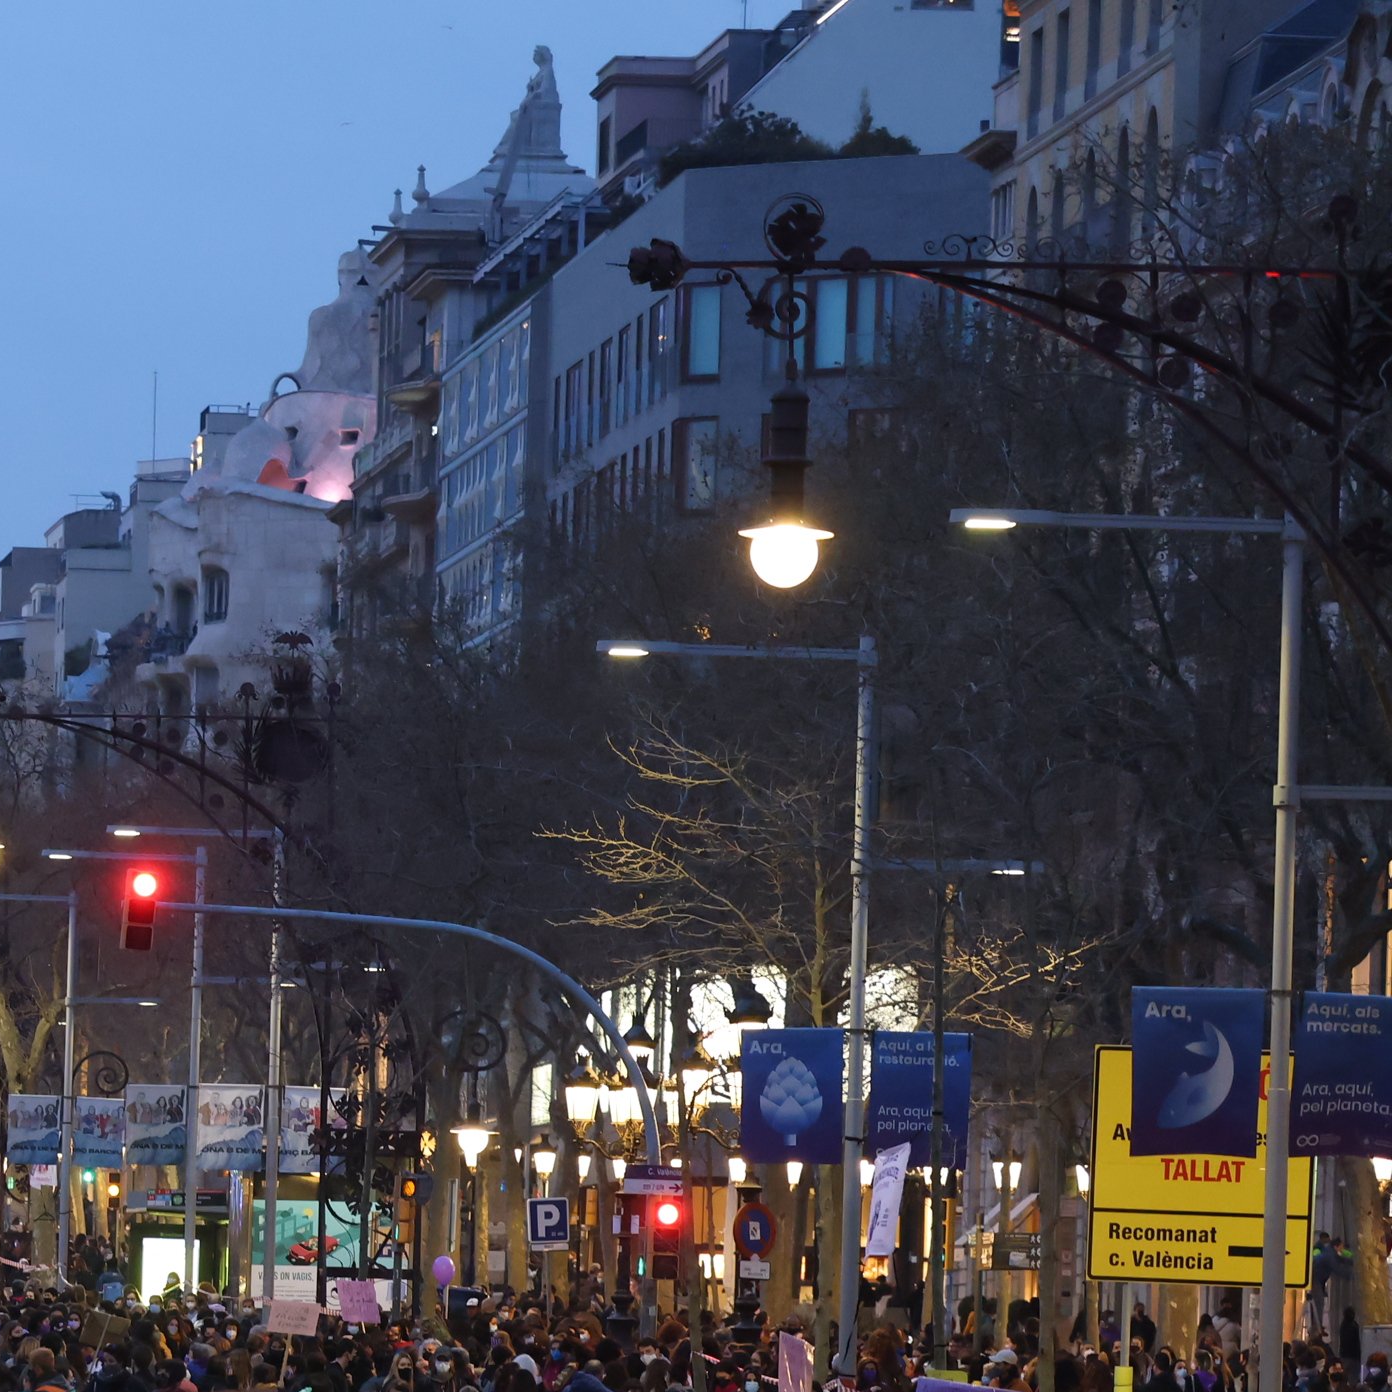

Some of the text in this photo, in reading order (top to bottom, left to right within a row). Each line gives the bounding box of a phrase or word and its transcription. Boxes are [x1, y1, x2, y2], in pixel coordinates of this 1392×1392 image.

[1145, 1001, 1192, 1022] Ara,
[1307, 1002, 1381, 1019] Aquí, als
[1306, 1020, 1382, 1035] mercats.
[749, 1039, 786, 1057] Ara,
[878, 1040, 913, 1053] Aquí,
[916, 1042, 925, 1052] a
[878, 1054, 960, 1067] restauraió.
[1302, 1081, 1374, 1098] Ara, aquí,
[877, 1105, 934, 1119] Ara, aquí
[1300, 1099, 1324, 1117] pel
[877, 1119, 952, 1134] pel planea.
[1160, 1158, 1245, 1183] TALLAT
[537, 1203, 561, 1238] P
[1109, 1222, 1217, 1244] Recomanat
[1109, 1250, 1214, 1270] c. València
[280, 1271, 291, 1281] ON
[292, 1271, 315, 1282] VAGIS,
